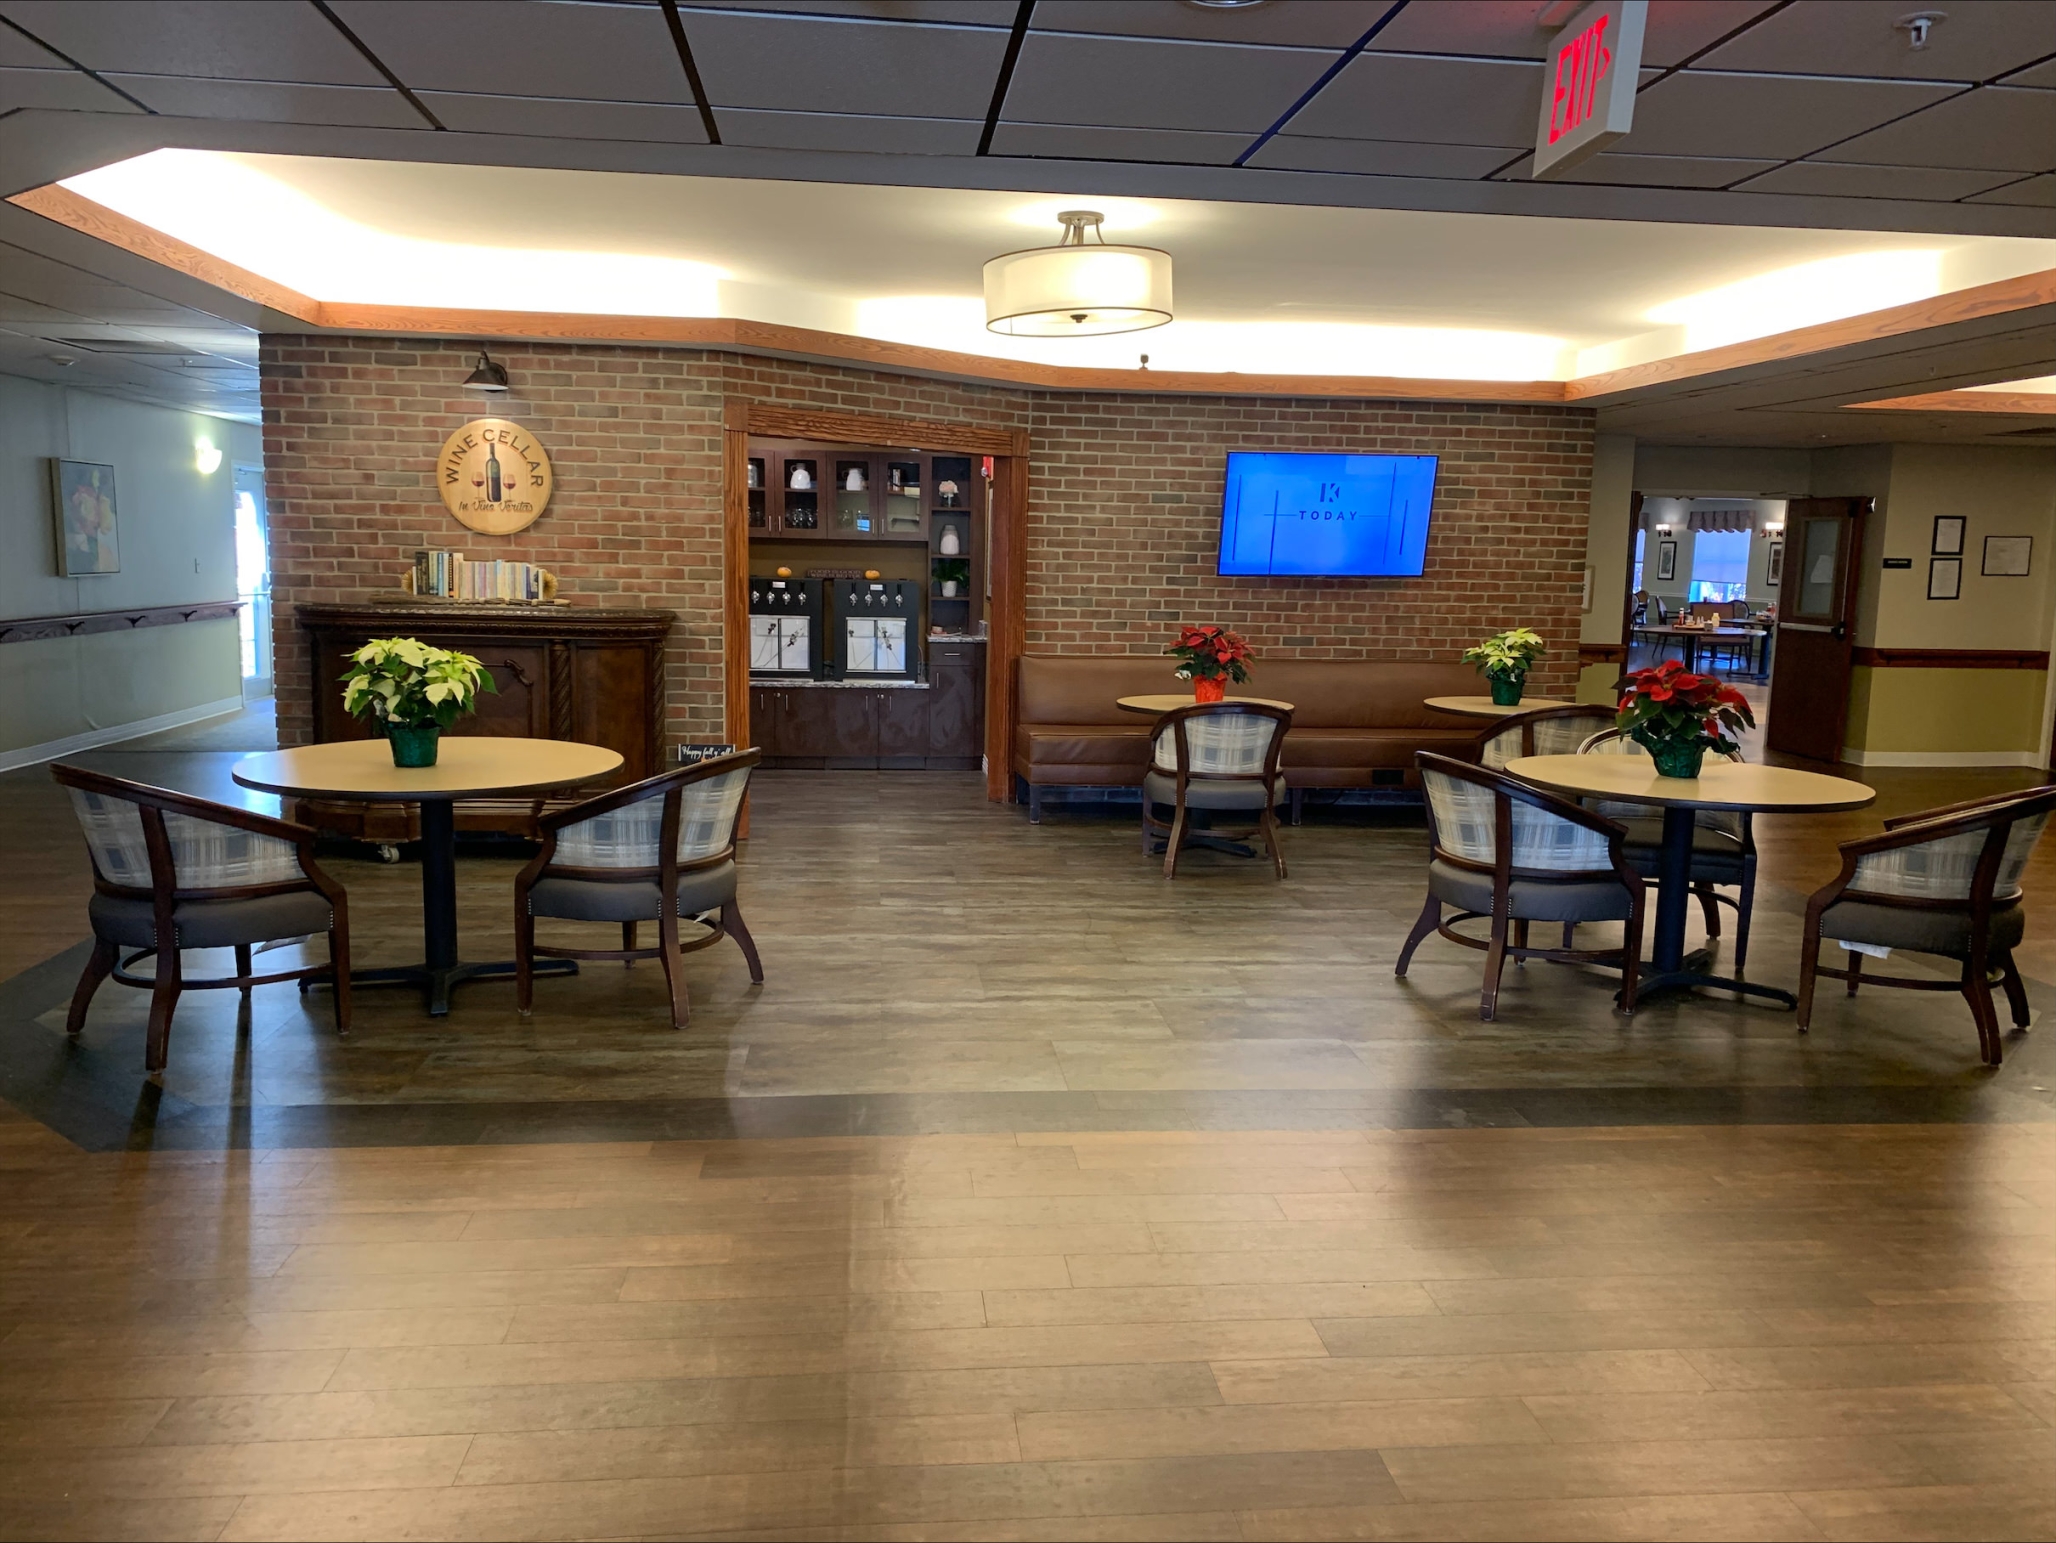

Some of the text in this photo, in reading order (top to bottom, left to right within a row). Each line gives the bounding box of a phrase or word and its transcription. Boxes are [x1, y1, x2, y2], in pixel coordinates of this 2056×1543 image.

[1547, 13, 1609, 146] EXIT
[445, 428, 544, 489] WINE CELLAR
[472, 497, 495, 512] Vino
[497, 499, 533, 512] Veritas
[1299, 510, 1358, 521] TODAY
[682, 745, 702, 760] Happy
